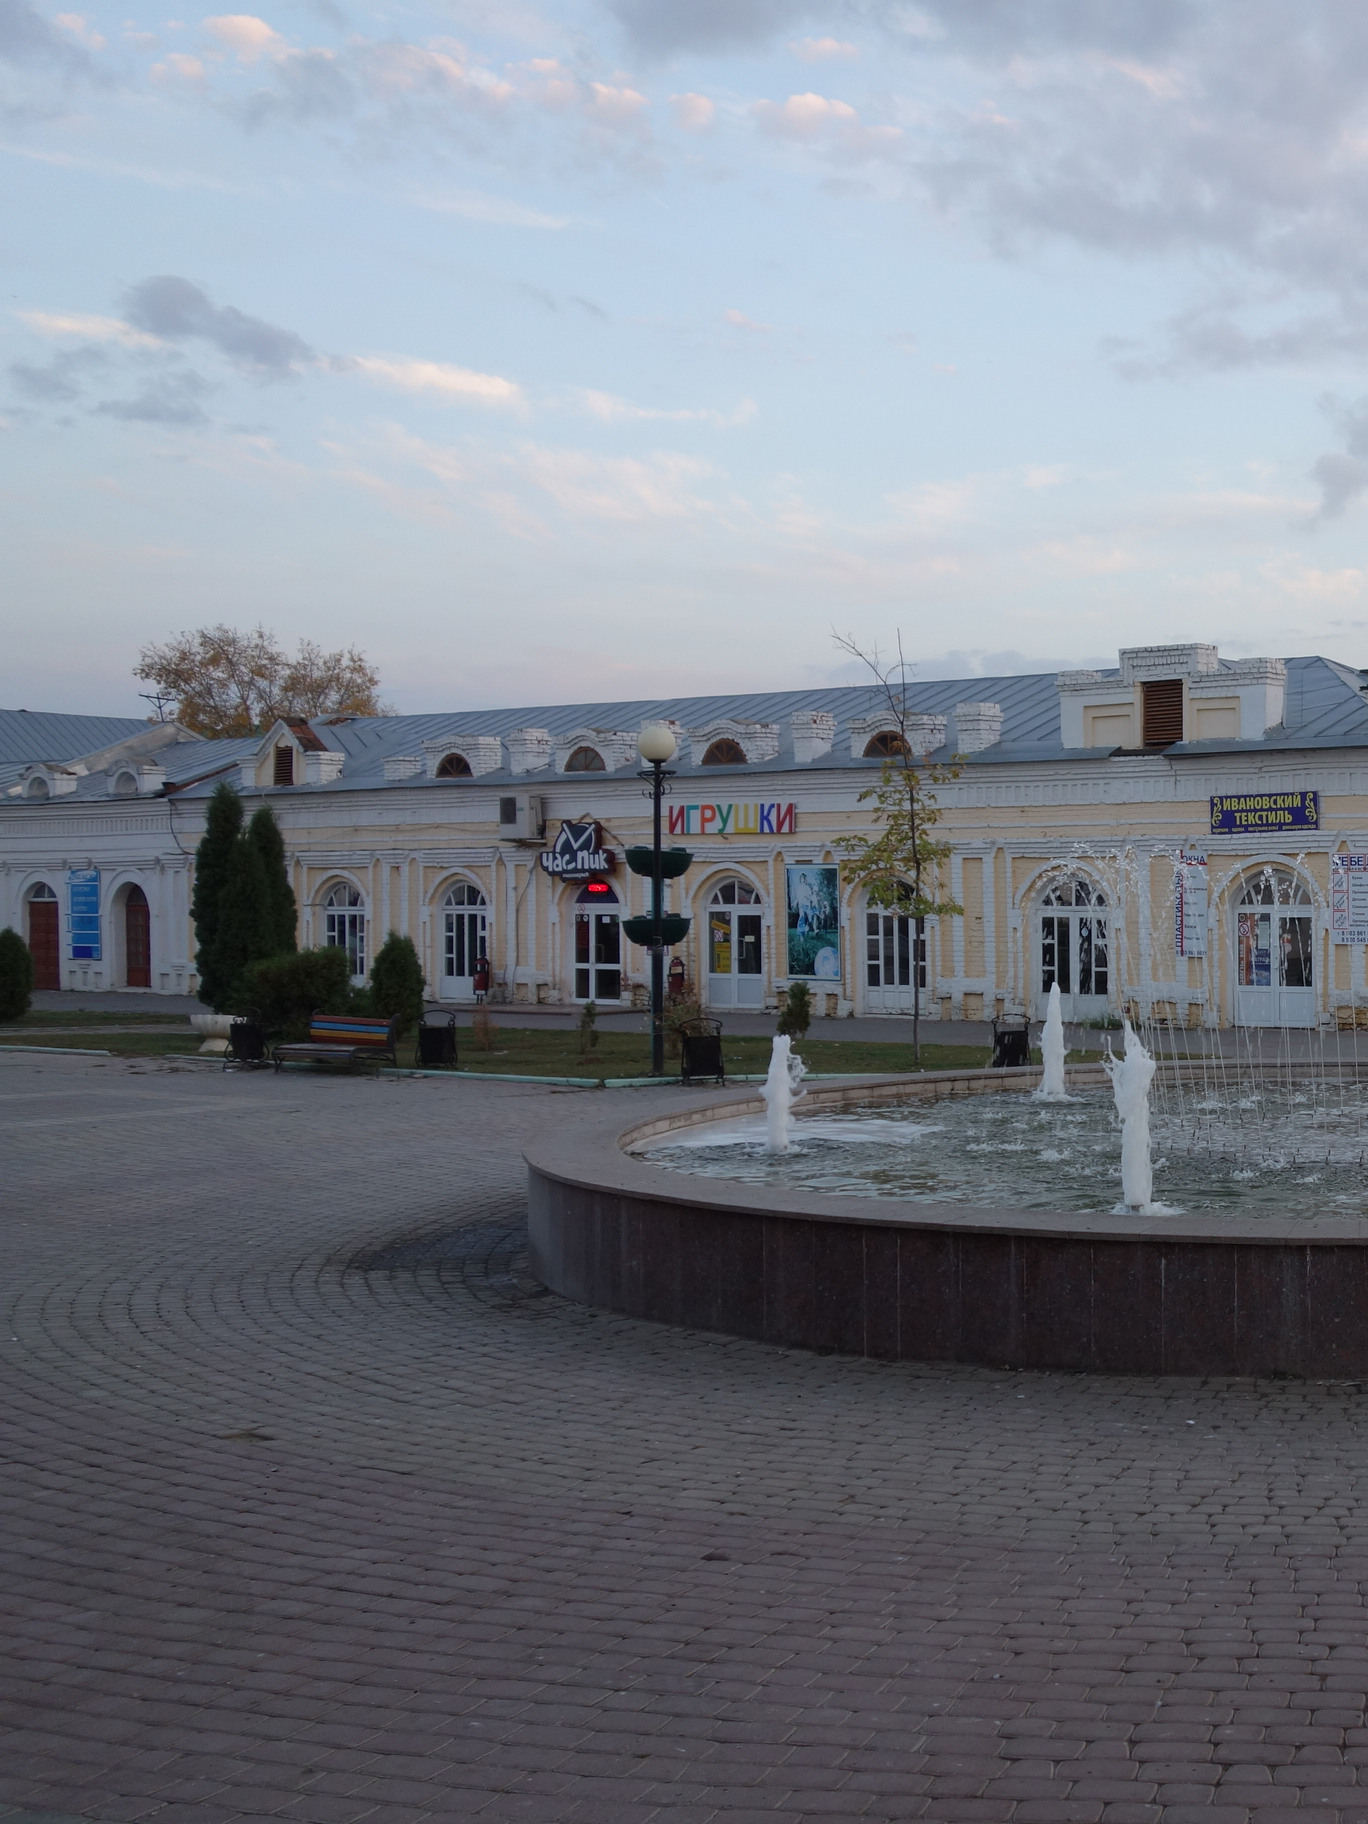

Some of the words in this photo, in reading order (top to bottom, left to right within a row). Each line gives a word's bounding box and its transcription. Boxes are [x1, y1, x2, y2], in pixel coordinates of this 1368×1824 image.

[1223, 793, 1302, 811] ИВАНОВСКИЙ
[669, 803, 795, 834] ИГРУШКИ
[1234, 811, 1293, 825] ТЕКСТИЛЬ
